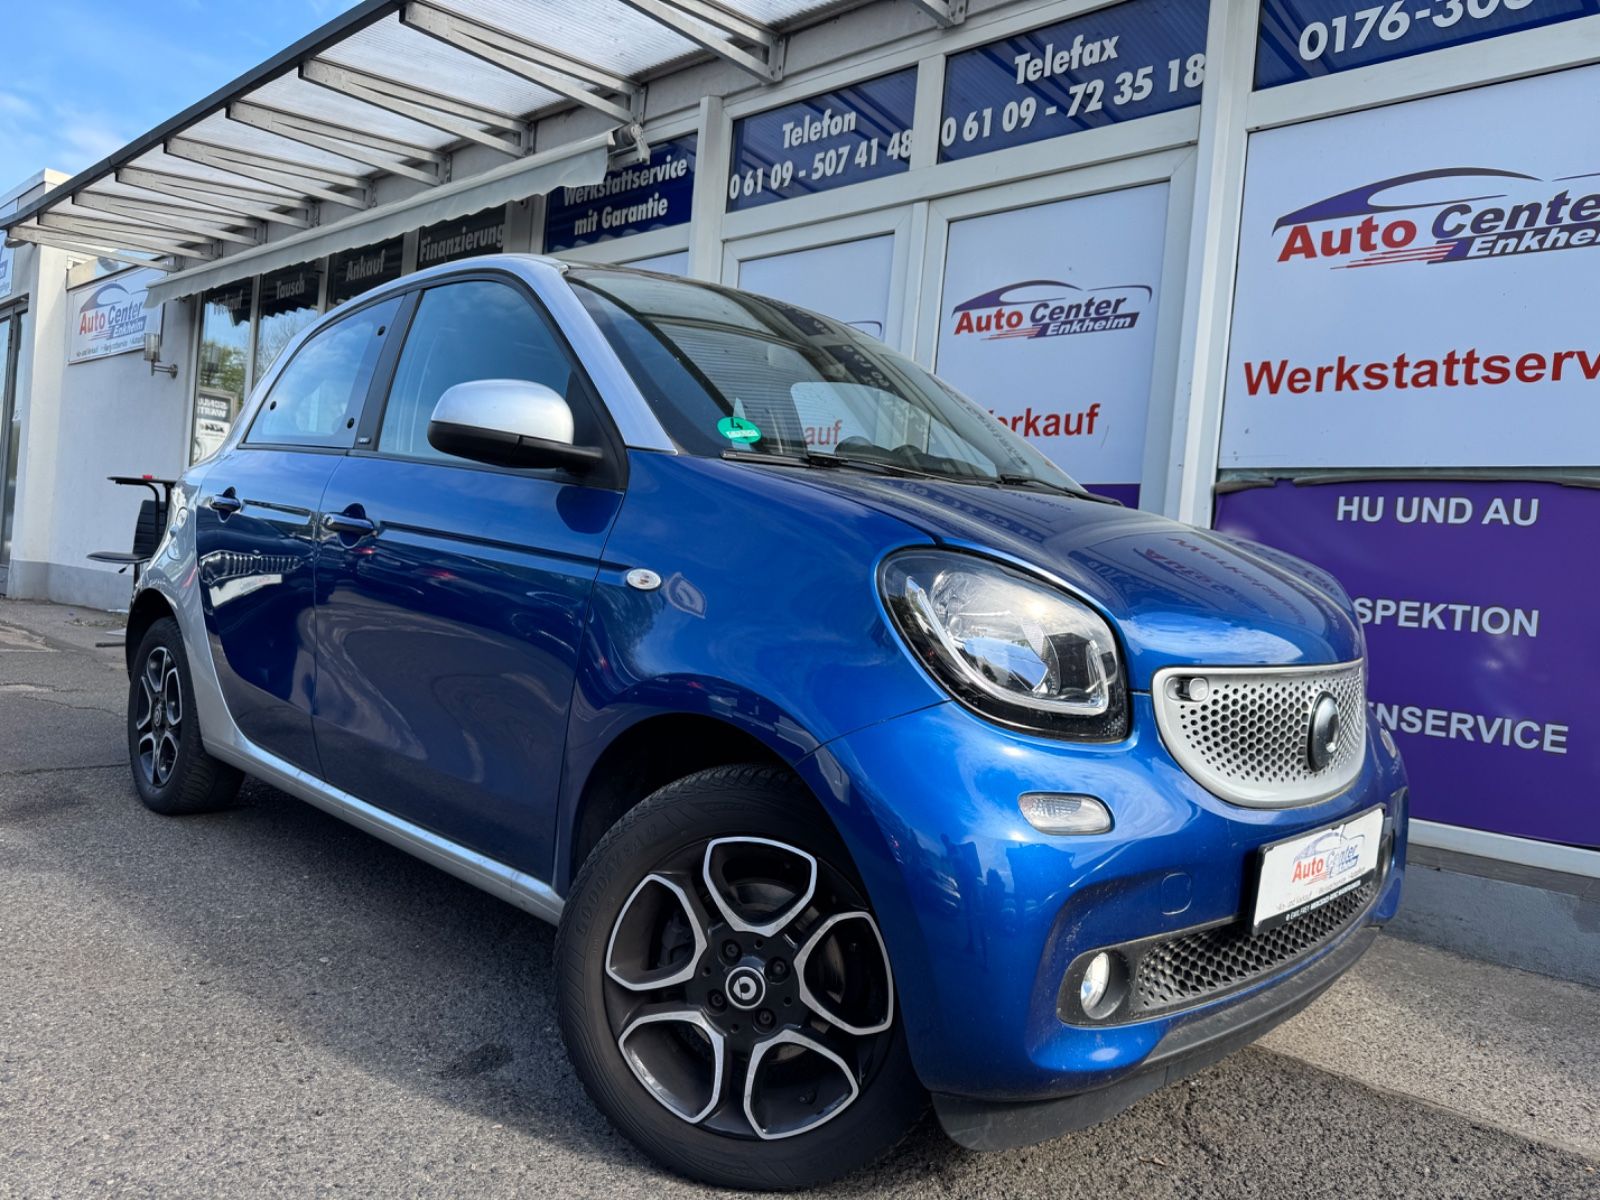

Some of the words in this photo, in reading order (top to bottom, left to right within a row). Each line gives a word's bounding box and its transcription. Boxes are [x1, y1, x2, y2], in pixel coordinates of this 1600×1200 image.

[1014, 34, 1120, 85] Telefax
[941, 117, 957, 147] 0
[962, 107, 993, 142] 61
[1002, 96, 1037, 132] 09
[1067, 79, 1105, 117] 72
[1113, 65, 1154, 105] 35
[1168, 53, 1206, 93] 18
[782, 108, 857, 149] Telefon
[563, 154, 688, 207] Werkstattservice
[729, 174, 740, 199] 0
[743, 168, 764, 196] 61
[770, 160, 794, 190] 09
[811, 144, 850, 180] 507
[855, 138, 878, 168] 41
[886, 128, 913, 160] 48
[574, 209, 599, 236] mit
[601, 192, 669, 229] Garantie
[1277, 215, 1417, 263] Auto
[1432, 189, 1600, 239] Cente
[419, 223, 504, 263] Finanzierung
[276, 271, 305, 300] Tausch
[345, 249, 386, 282] Ankauf
[79, 310, 106, 335] Auto
[108, 301, 143, 325] Center
[954, 308, 1023, 335] Auto
[1030, 296, 1128, 324] Center
[1047, 314, 1132, 336] Enkheim
[1244, 348, 1600, 396] Werkstattserv
[988, 402, 1101, 438] rkauf
[1336, 496, 1384, 522] HU
[1395, 497, 1473, 525] UND
[1481, 498, 1540, 526] AU
[1353, 597, 1540, 638] SPEKTION
[1367, 701, 1569, 754] NSERVICE
[1291, 856, 1325, 883] Auto
